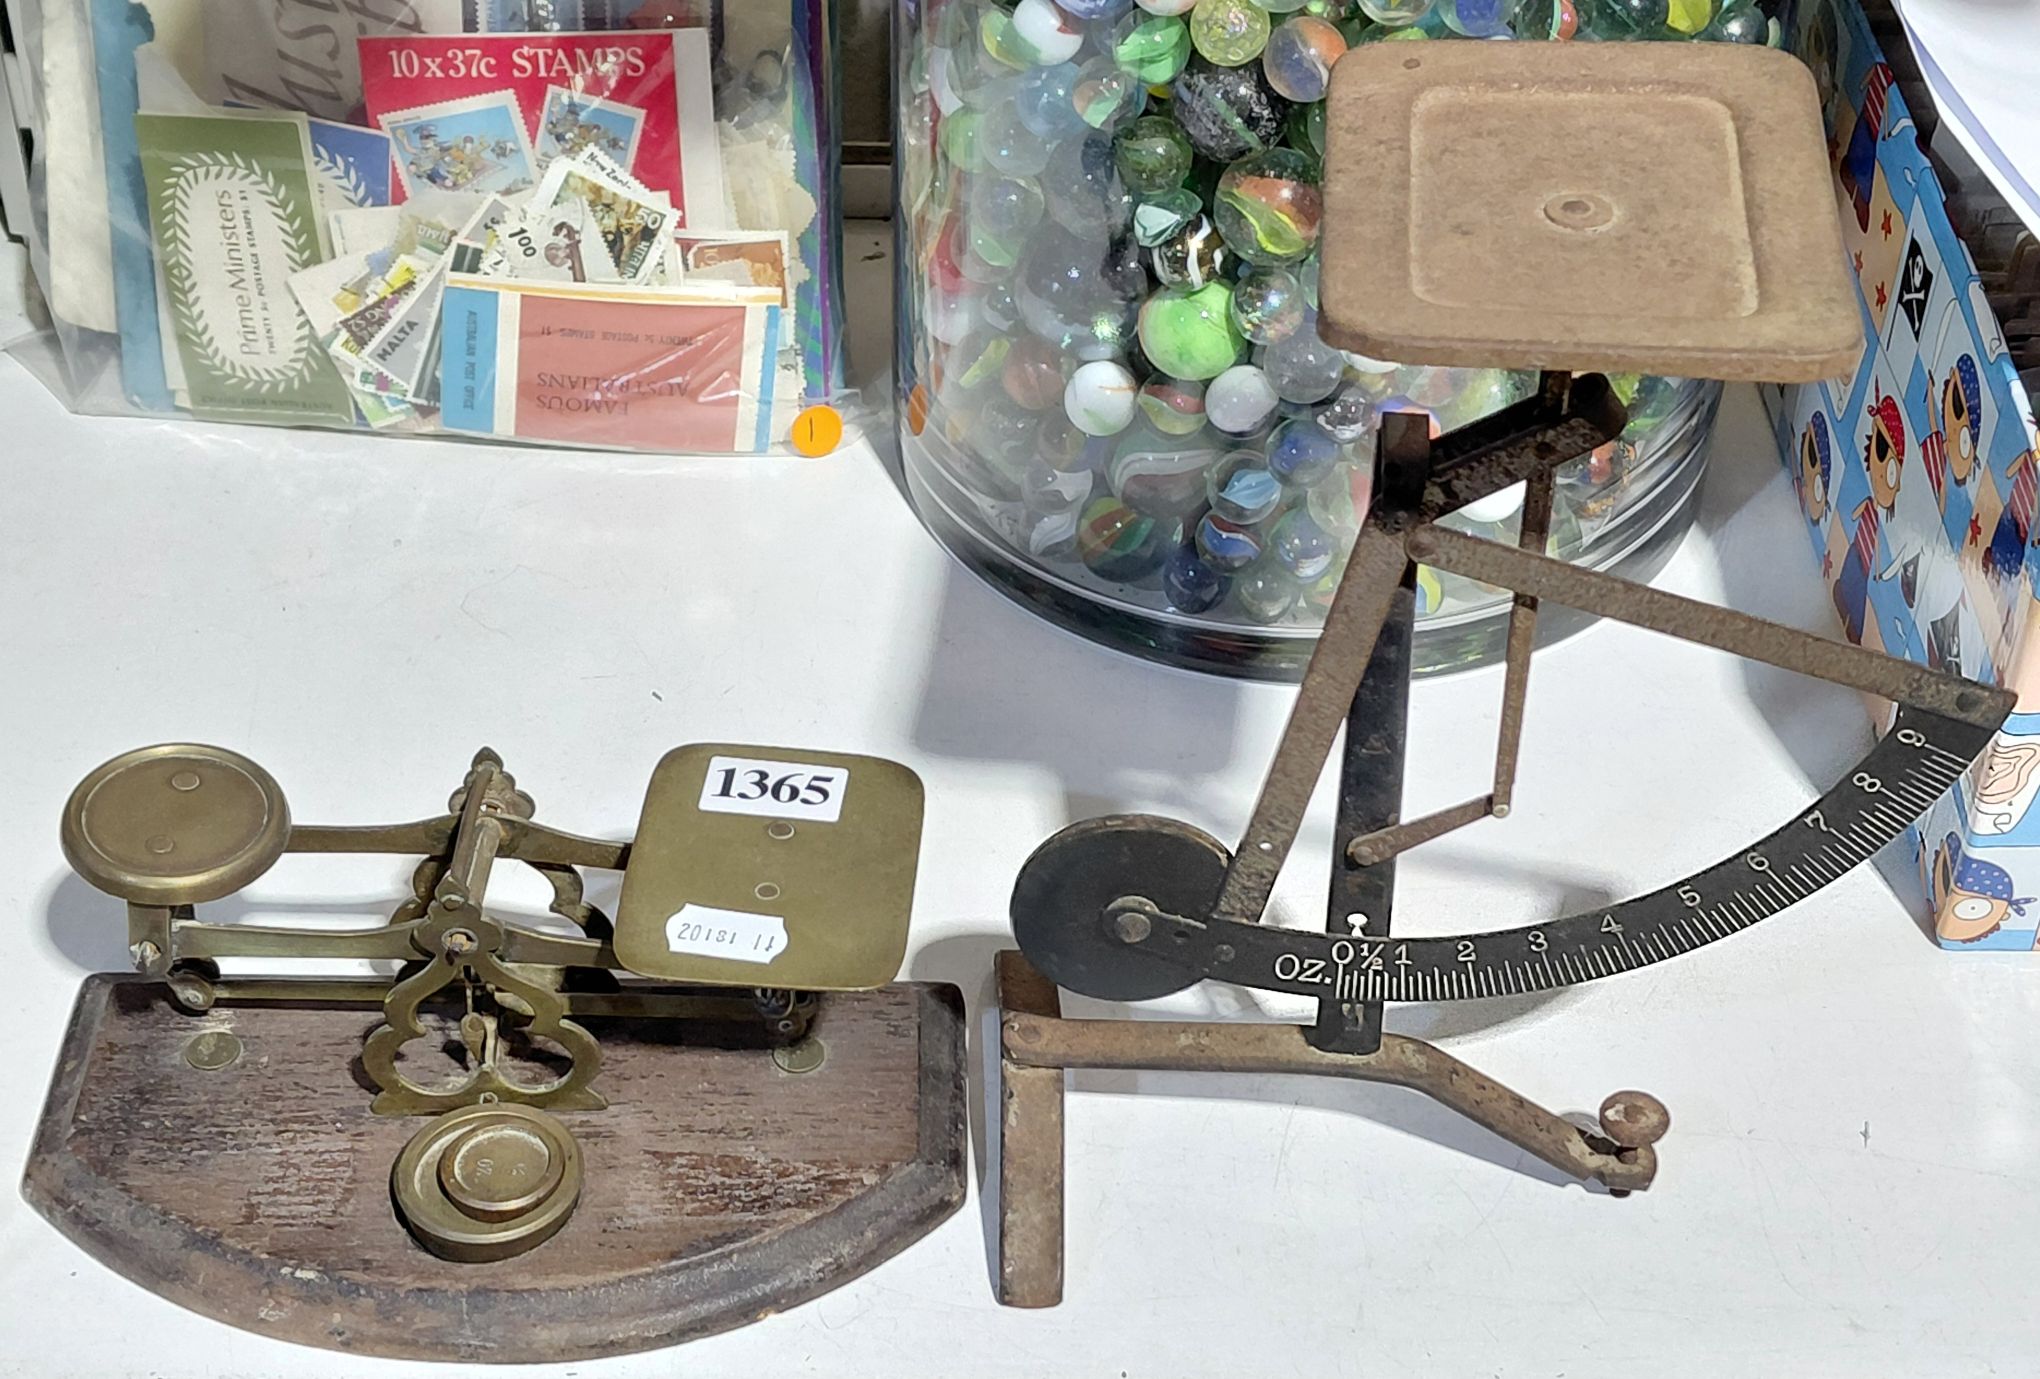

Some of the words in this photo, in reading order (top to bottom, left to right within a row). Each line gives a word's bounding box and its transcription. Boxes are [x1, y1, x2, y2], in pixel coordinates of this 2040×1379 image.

[512, 45, 646, 78] STAMPS
[215, 189, 248, 291] Ministers
[507, 226, 538, 259] 100
[235, 294, 261, 356] Prime
[375, 319, 420, 363] MALTA
[536, 371, 690, 398] AUSTRALIANS
[536, 393, 629, 416] FAMOUS
[710, 767, 835, 806] 1365
[1394, 944, 1413, 965] 1
[1456, 940, 1477, 962] 2
[1527, 930, 1549, 952] 3
[1600, 913, 1624, 934] 4
[1677, 884, 1702, 908] 5
[1746, 851, 1770, 872] 6
[1803, 809, 1828, 832] 7
[1852, 771, 1882, 793] 8
[1897, 728, 1927, 748] 9
